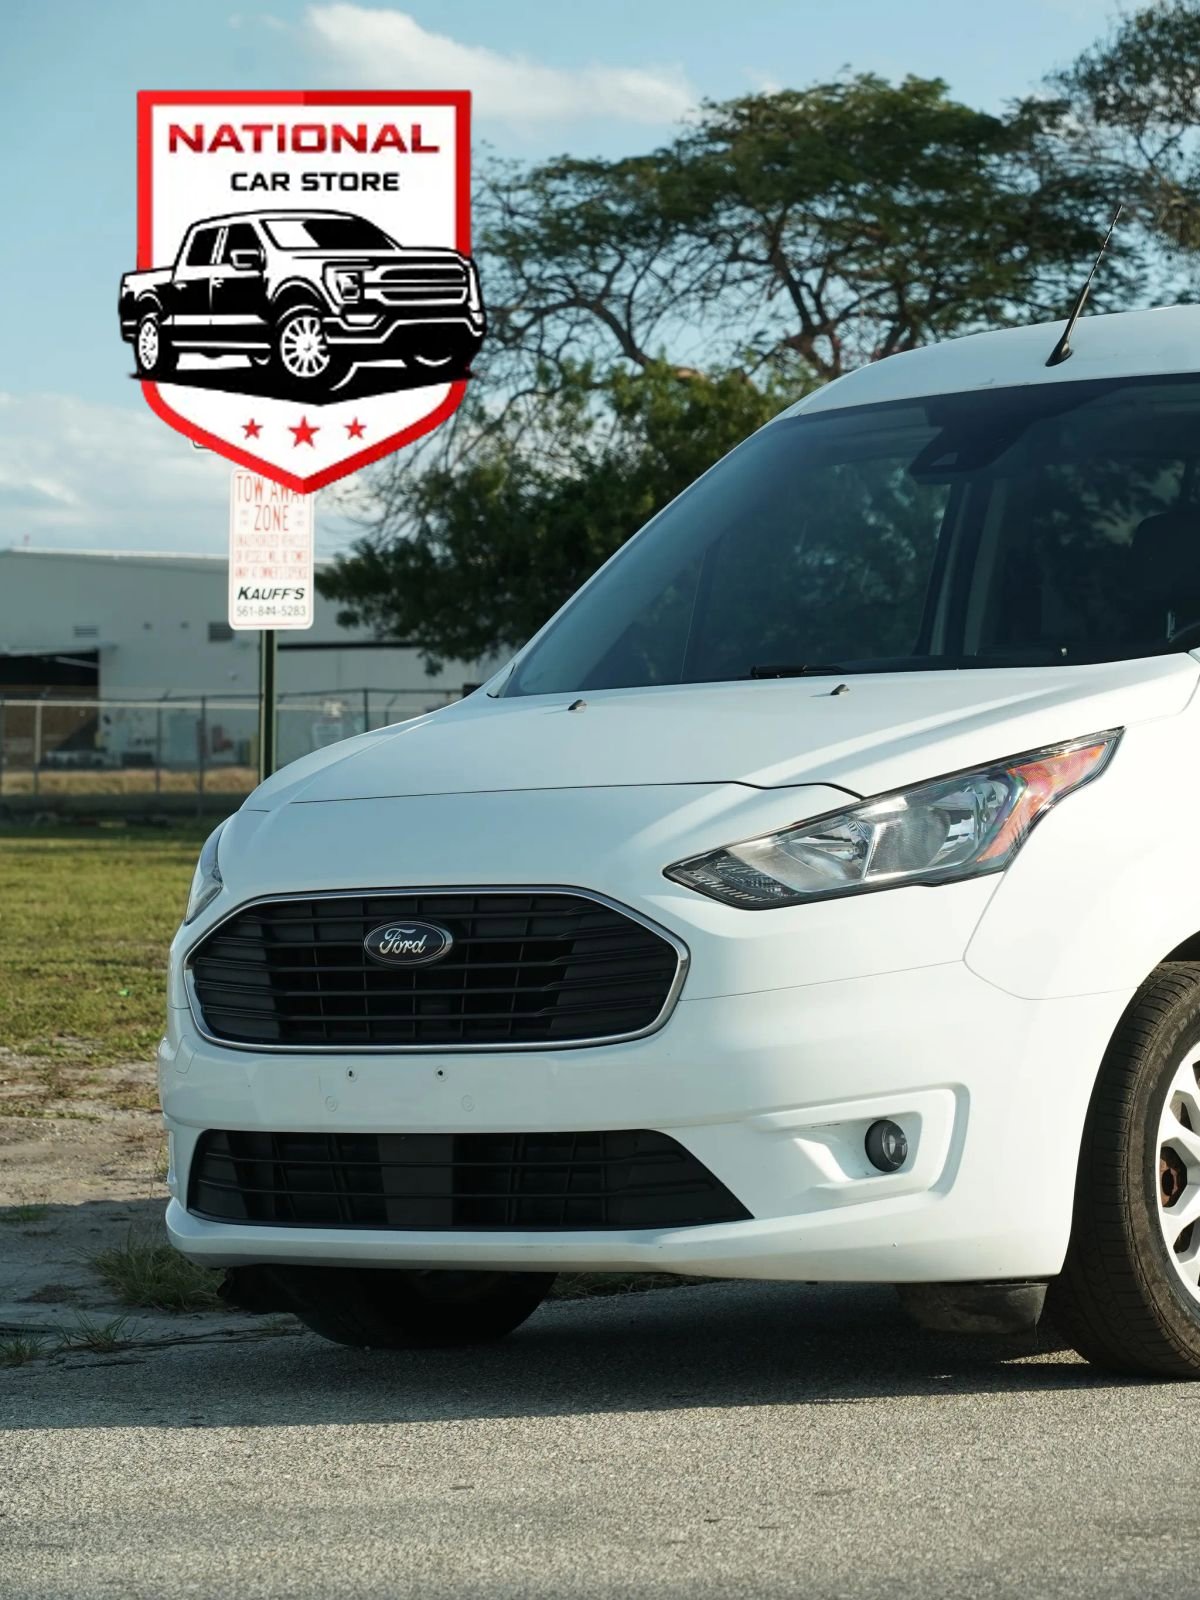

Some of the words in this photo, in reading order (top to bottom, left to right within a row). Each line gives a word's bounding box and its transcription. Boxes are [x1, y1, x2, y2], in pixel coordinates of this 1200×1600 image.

[236, 475, 264, 503] TOW
[270, 480, 306, 503] AW
[254, 504, 289, 531] ZONE
[379, 927, 428, 954] Ford
